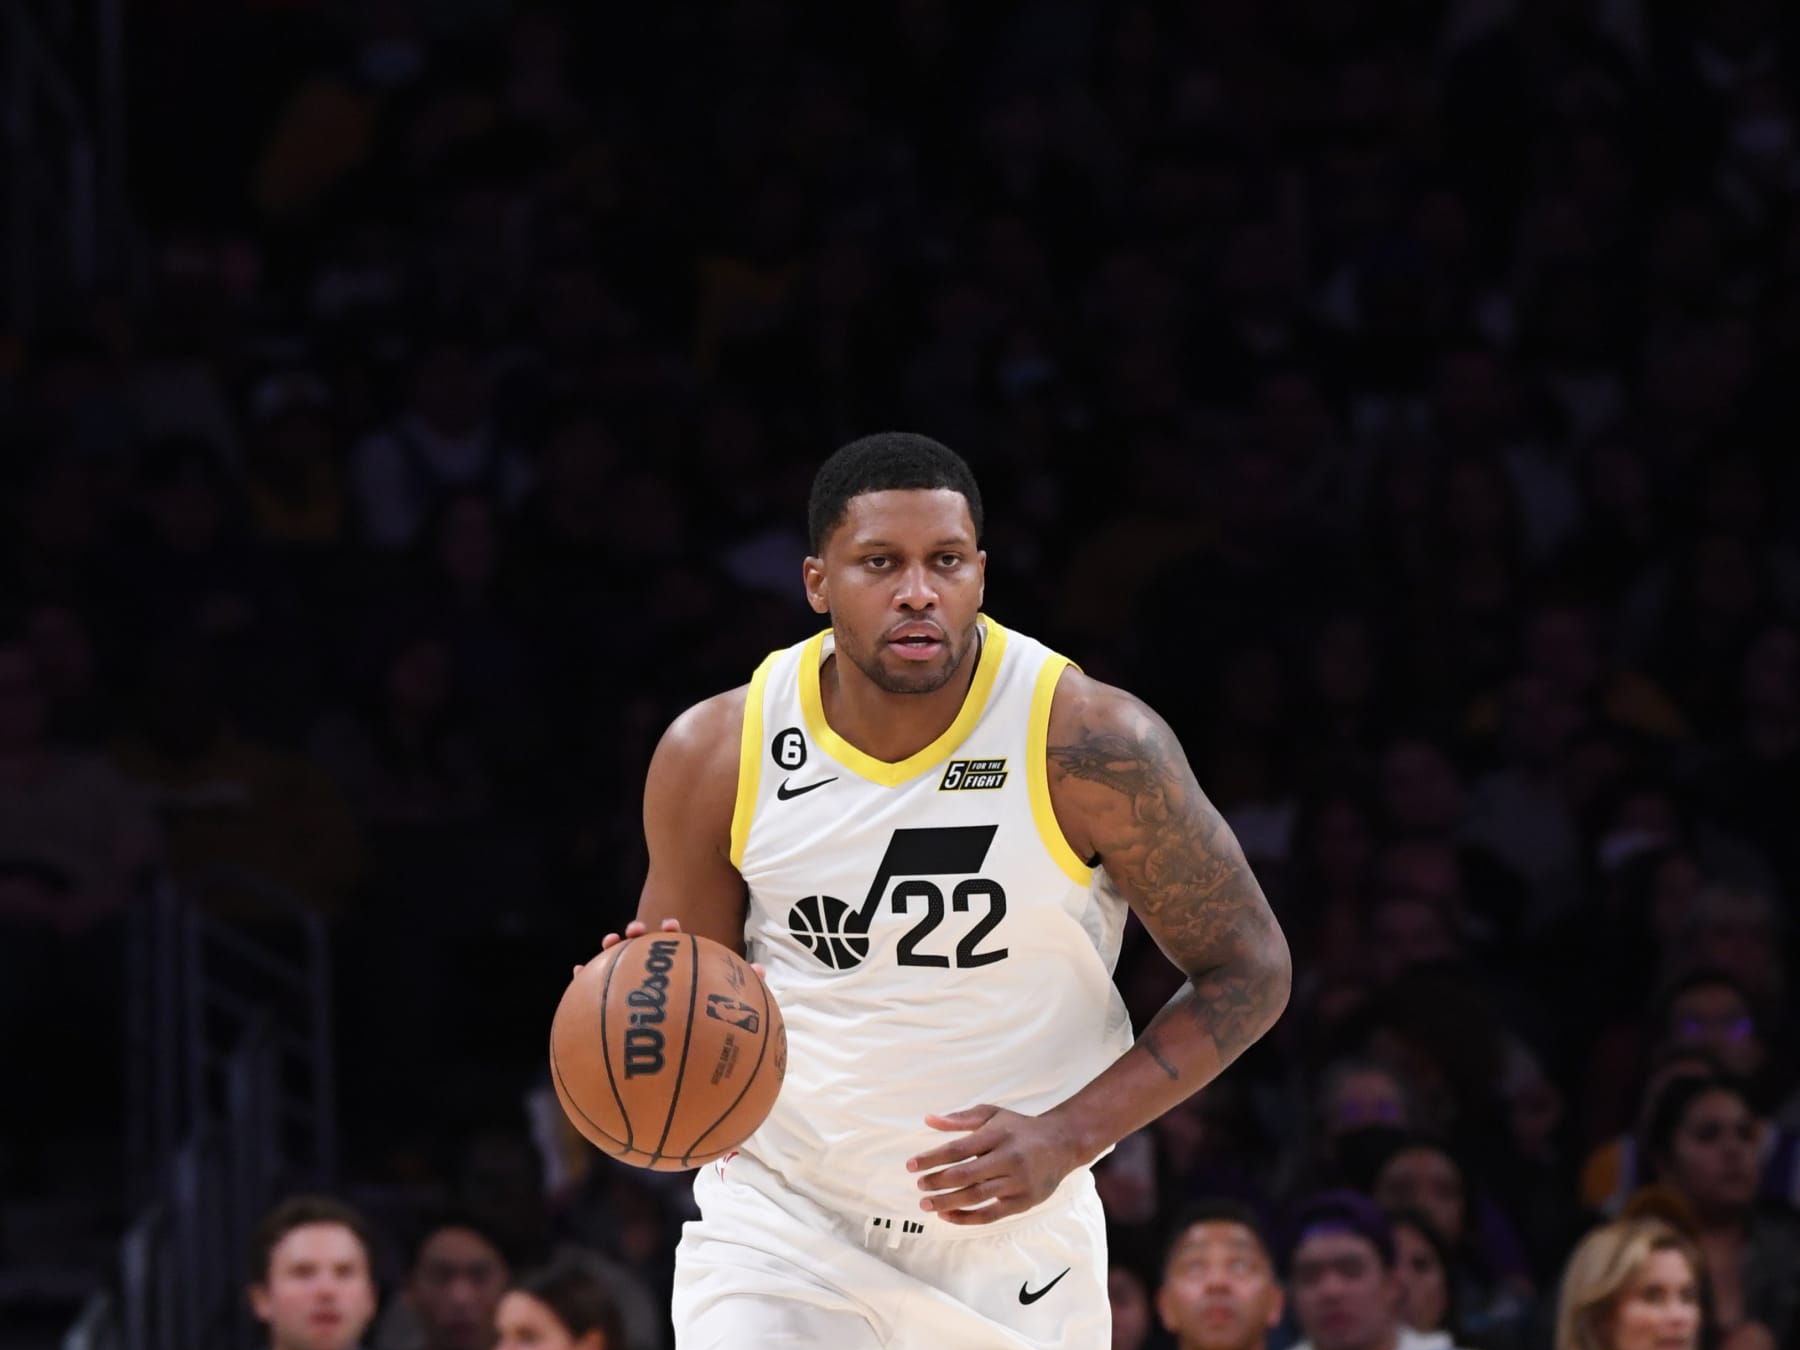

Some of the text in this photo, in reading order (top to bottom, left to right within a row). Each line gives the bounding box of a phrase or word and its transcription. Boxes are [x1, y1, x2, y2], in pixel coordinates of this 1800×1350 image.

[781, 733, 802, 766] 6
[944, 762, 966, 789] 5
[971, 761, 1003, 770] FOR THE
[964, 774, 1005, 788] FIGHT
[891, 878, 1009, 969] 22
[624, 940, 680, 1081] Wilson
